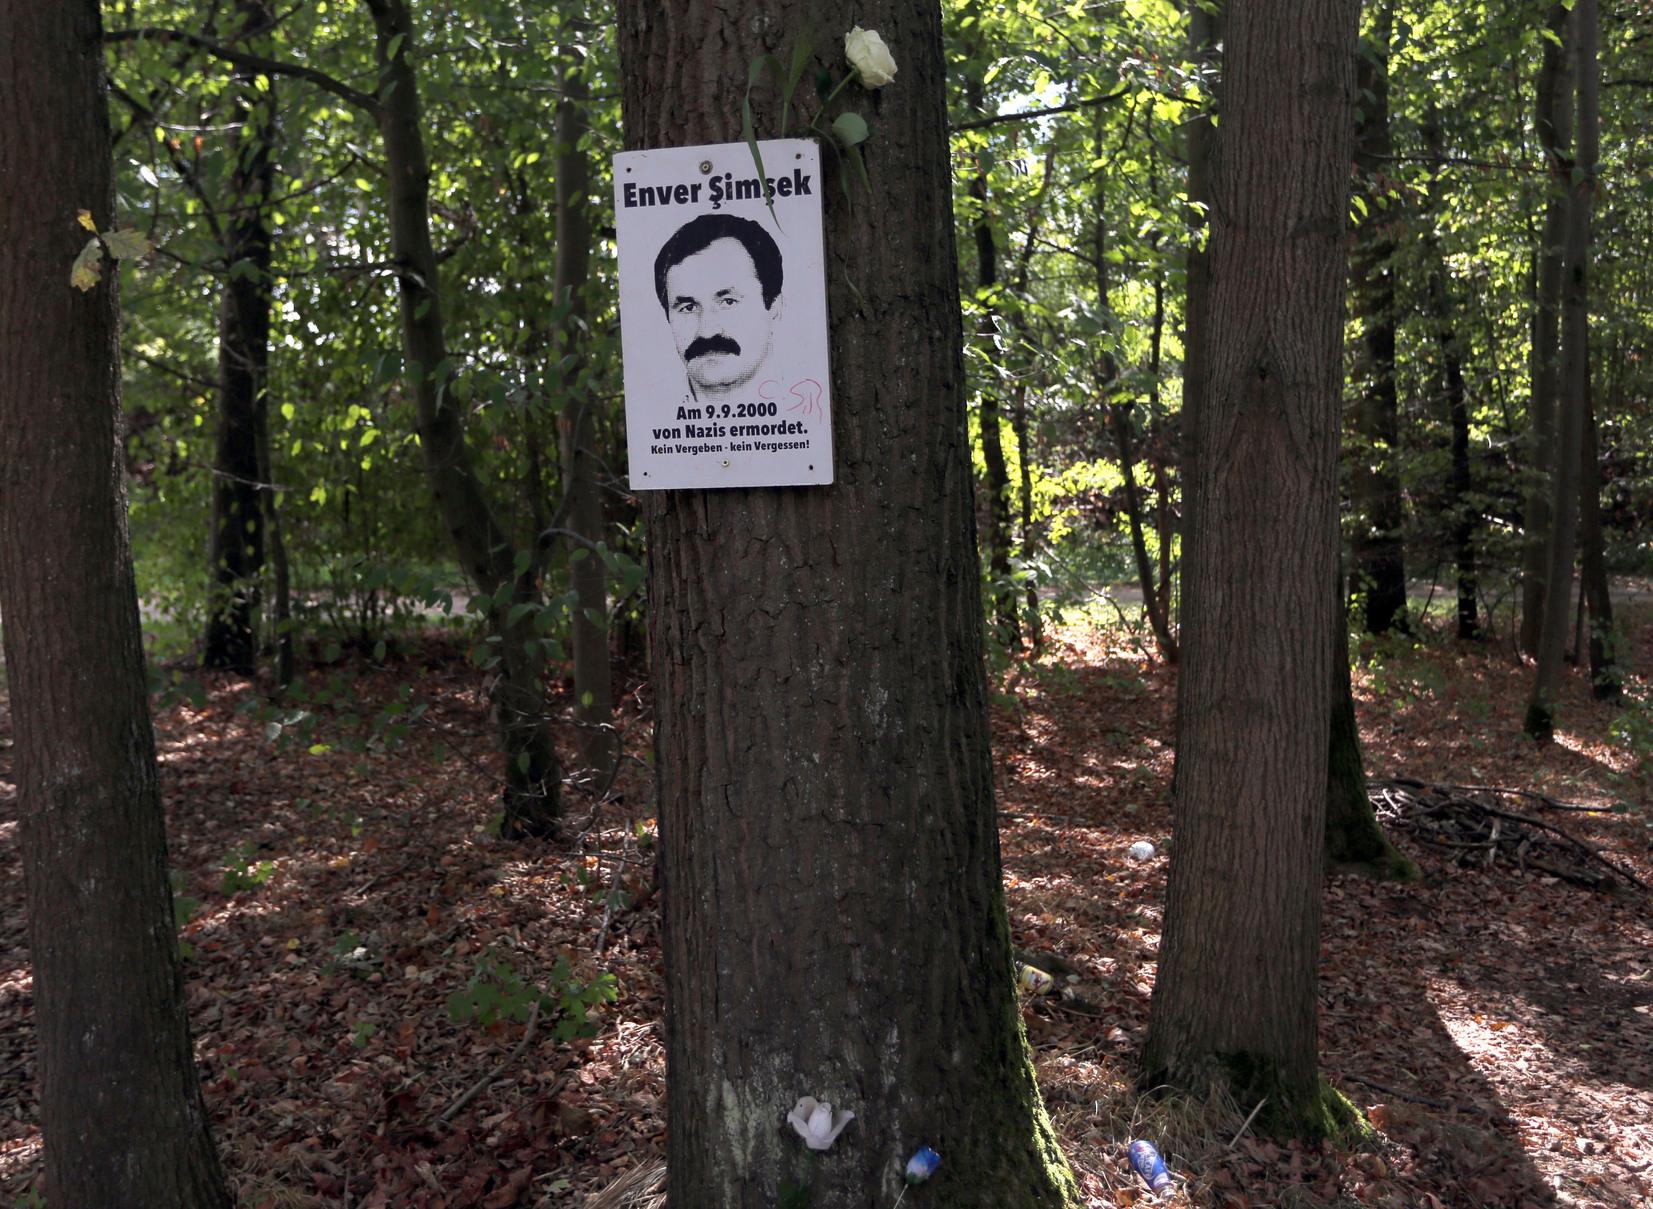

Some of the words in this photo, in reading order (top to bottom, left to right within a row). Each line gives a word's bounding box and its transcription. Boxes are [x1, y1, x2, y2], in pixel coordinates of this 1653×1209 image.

[623, 182, 702, 208] Enver
[708, 168, 812, 210] Şimşek
[676, 405, 702, 421] Am
[705, 402, 778, 419] 9.9.2000
[652, 427, 682, 440] von
[685, 422, 727, 439] Nazis
[729, 420, 809, 437] ermordet.
[651, 444, 674, 455] Kein
[675, 443, 723, 456] Vergeben
[730, 441, 752, 452] kein
[754, 440, 810, 453] Vergessen!
